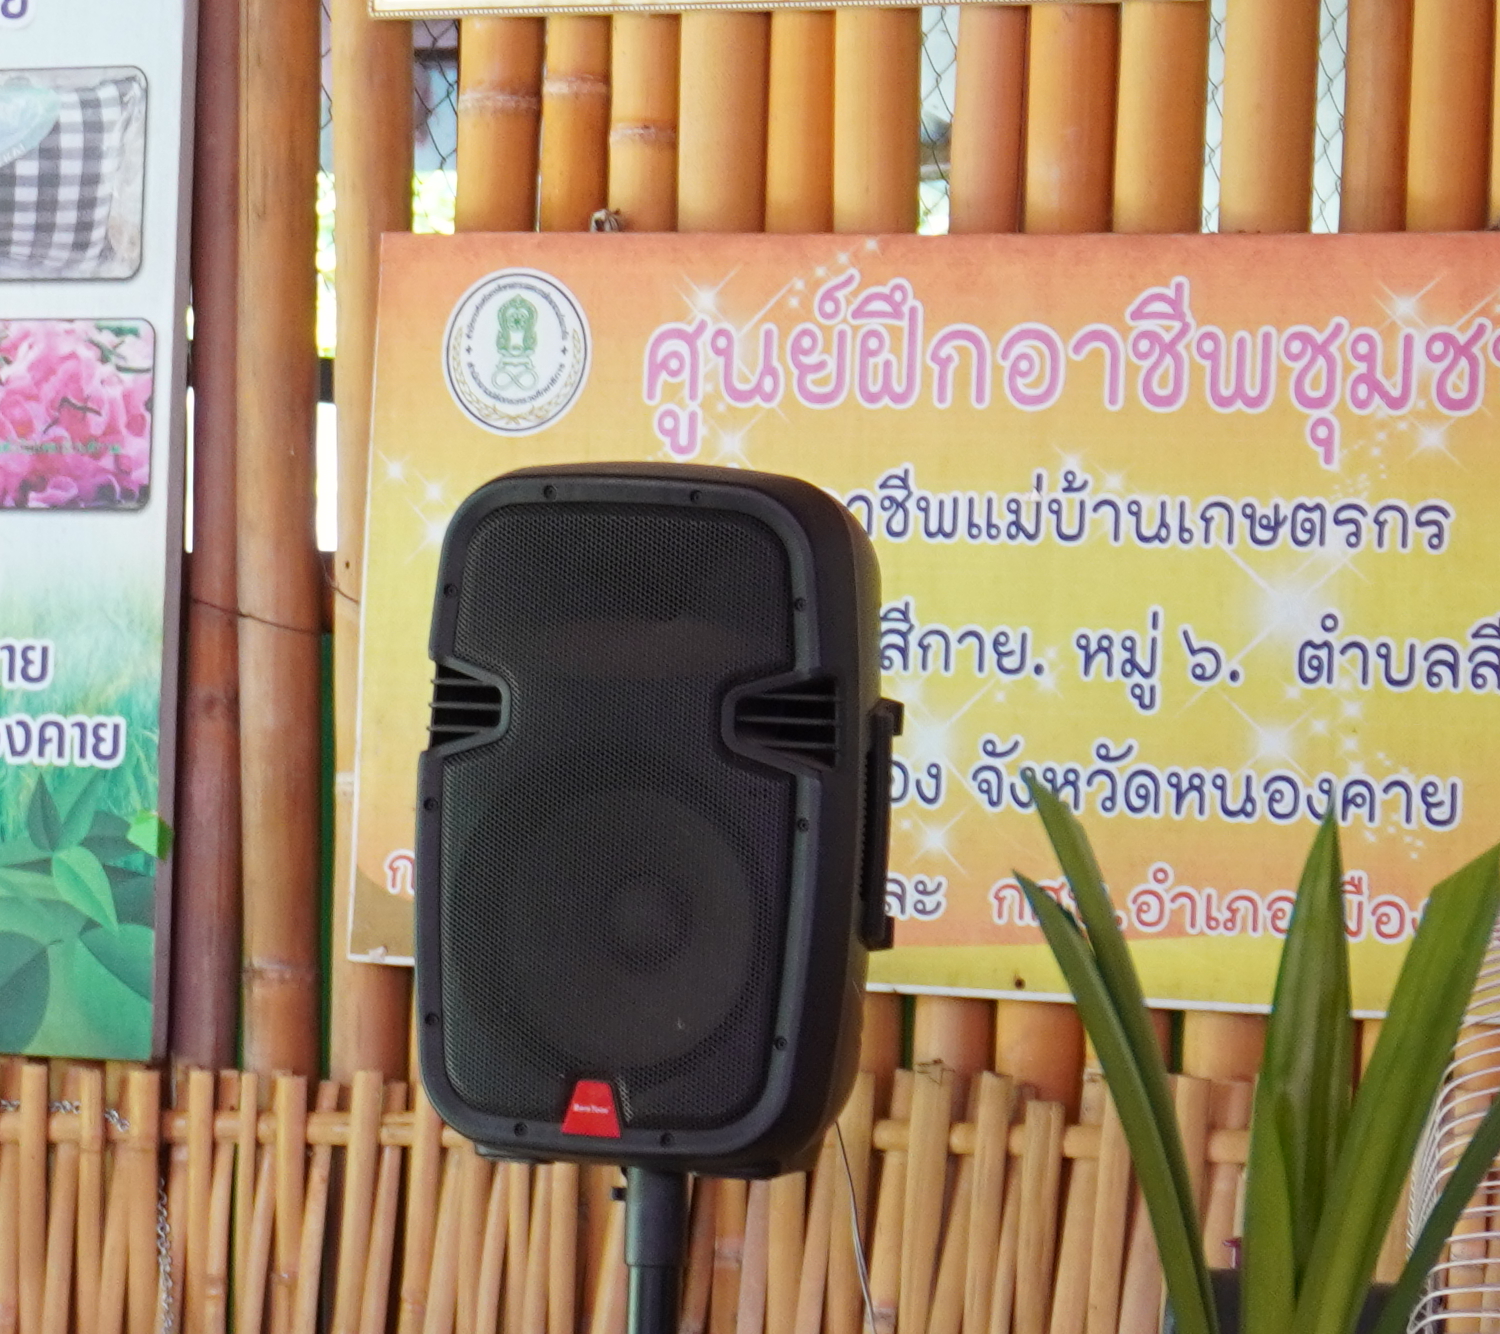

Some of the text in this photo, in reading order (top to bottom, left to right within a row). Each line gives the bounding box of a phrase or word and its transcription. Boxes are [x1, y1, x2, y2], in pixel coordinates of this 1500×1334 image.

[846, 467, 1450, 549] าชีพแม่บ้านเกษตรกร
[1076, 609, 1160, 708] หมู่
